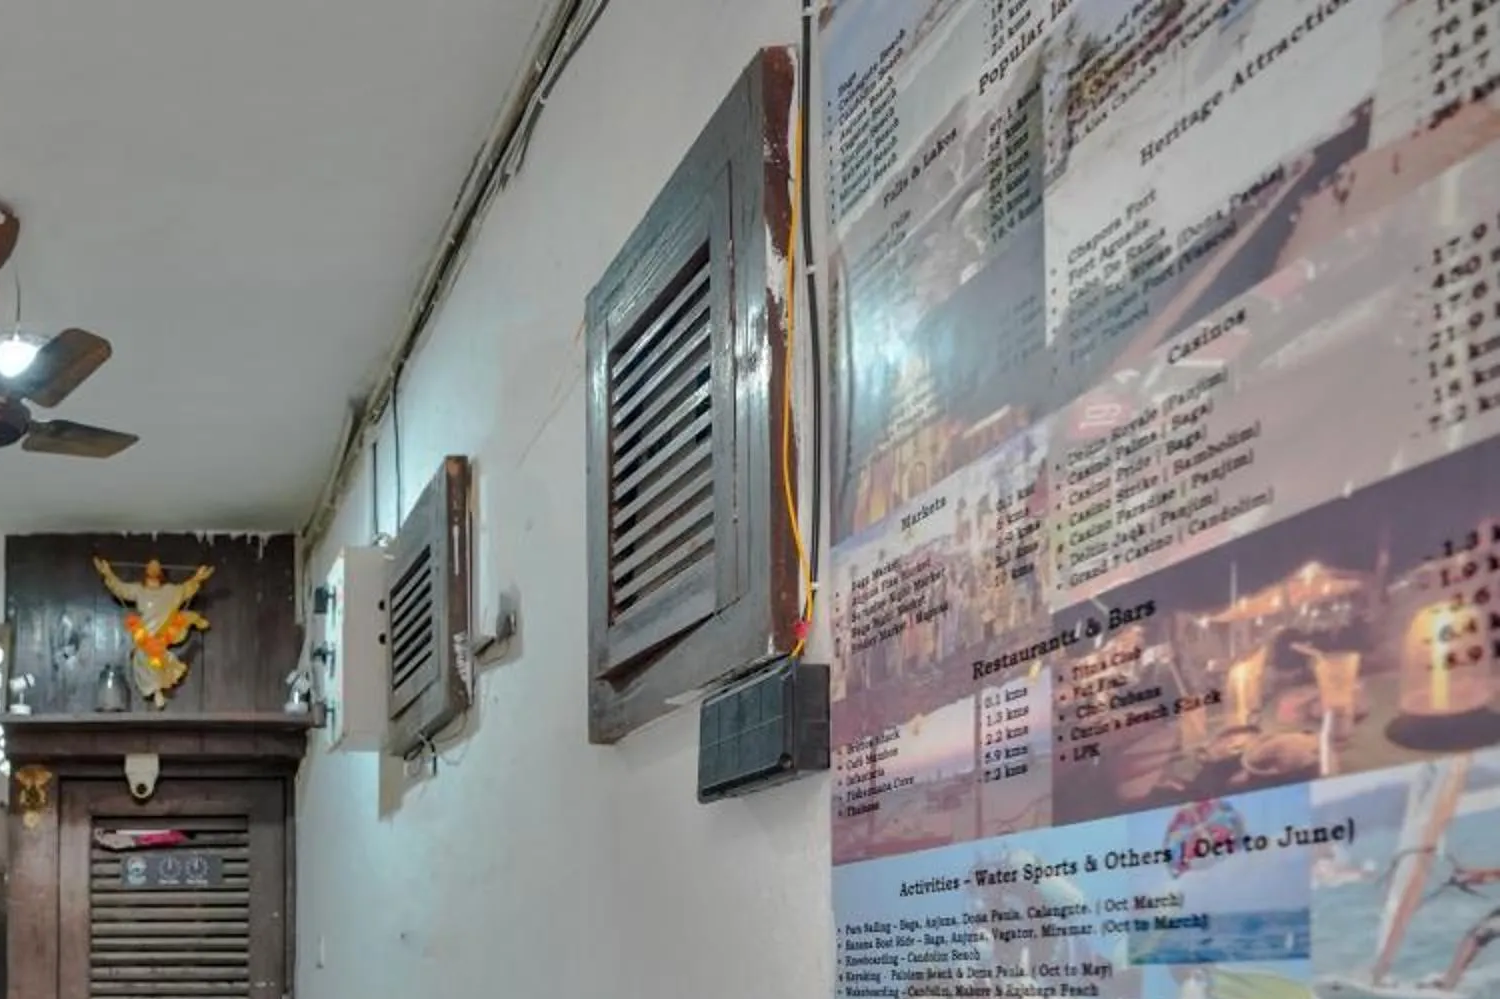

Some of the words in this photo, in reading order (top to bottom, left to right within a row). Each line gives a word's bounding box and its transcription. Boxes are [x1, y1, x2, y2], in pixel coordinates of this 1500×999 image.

[979, 18, 1045, 97] Popular
[1141, 89, 1225, 167] Heritage
[1167, 307, 1248, 365] Casinos
[901, 495, 949, 535] Markets
[1085, 617, 1103, 640] &
[1108, 599, 1157, 631] Bars
[899, 875, 960, 898] Activities
[975, 868, 1019, 887] Water
[1022, 859, 1078, 885] Sports
[1084, 853, 1098, 873] &
[1104, 846, 1173, 870] Others
[1243, 835, 1269, 853] to
